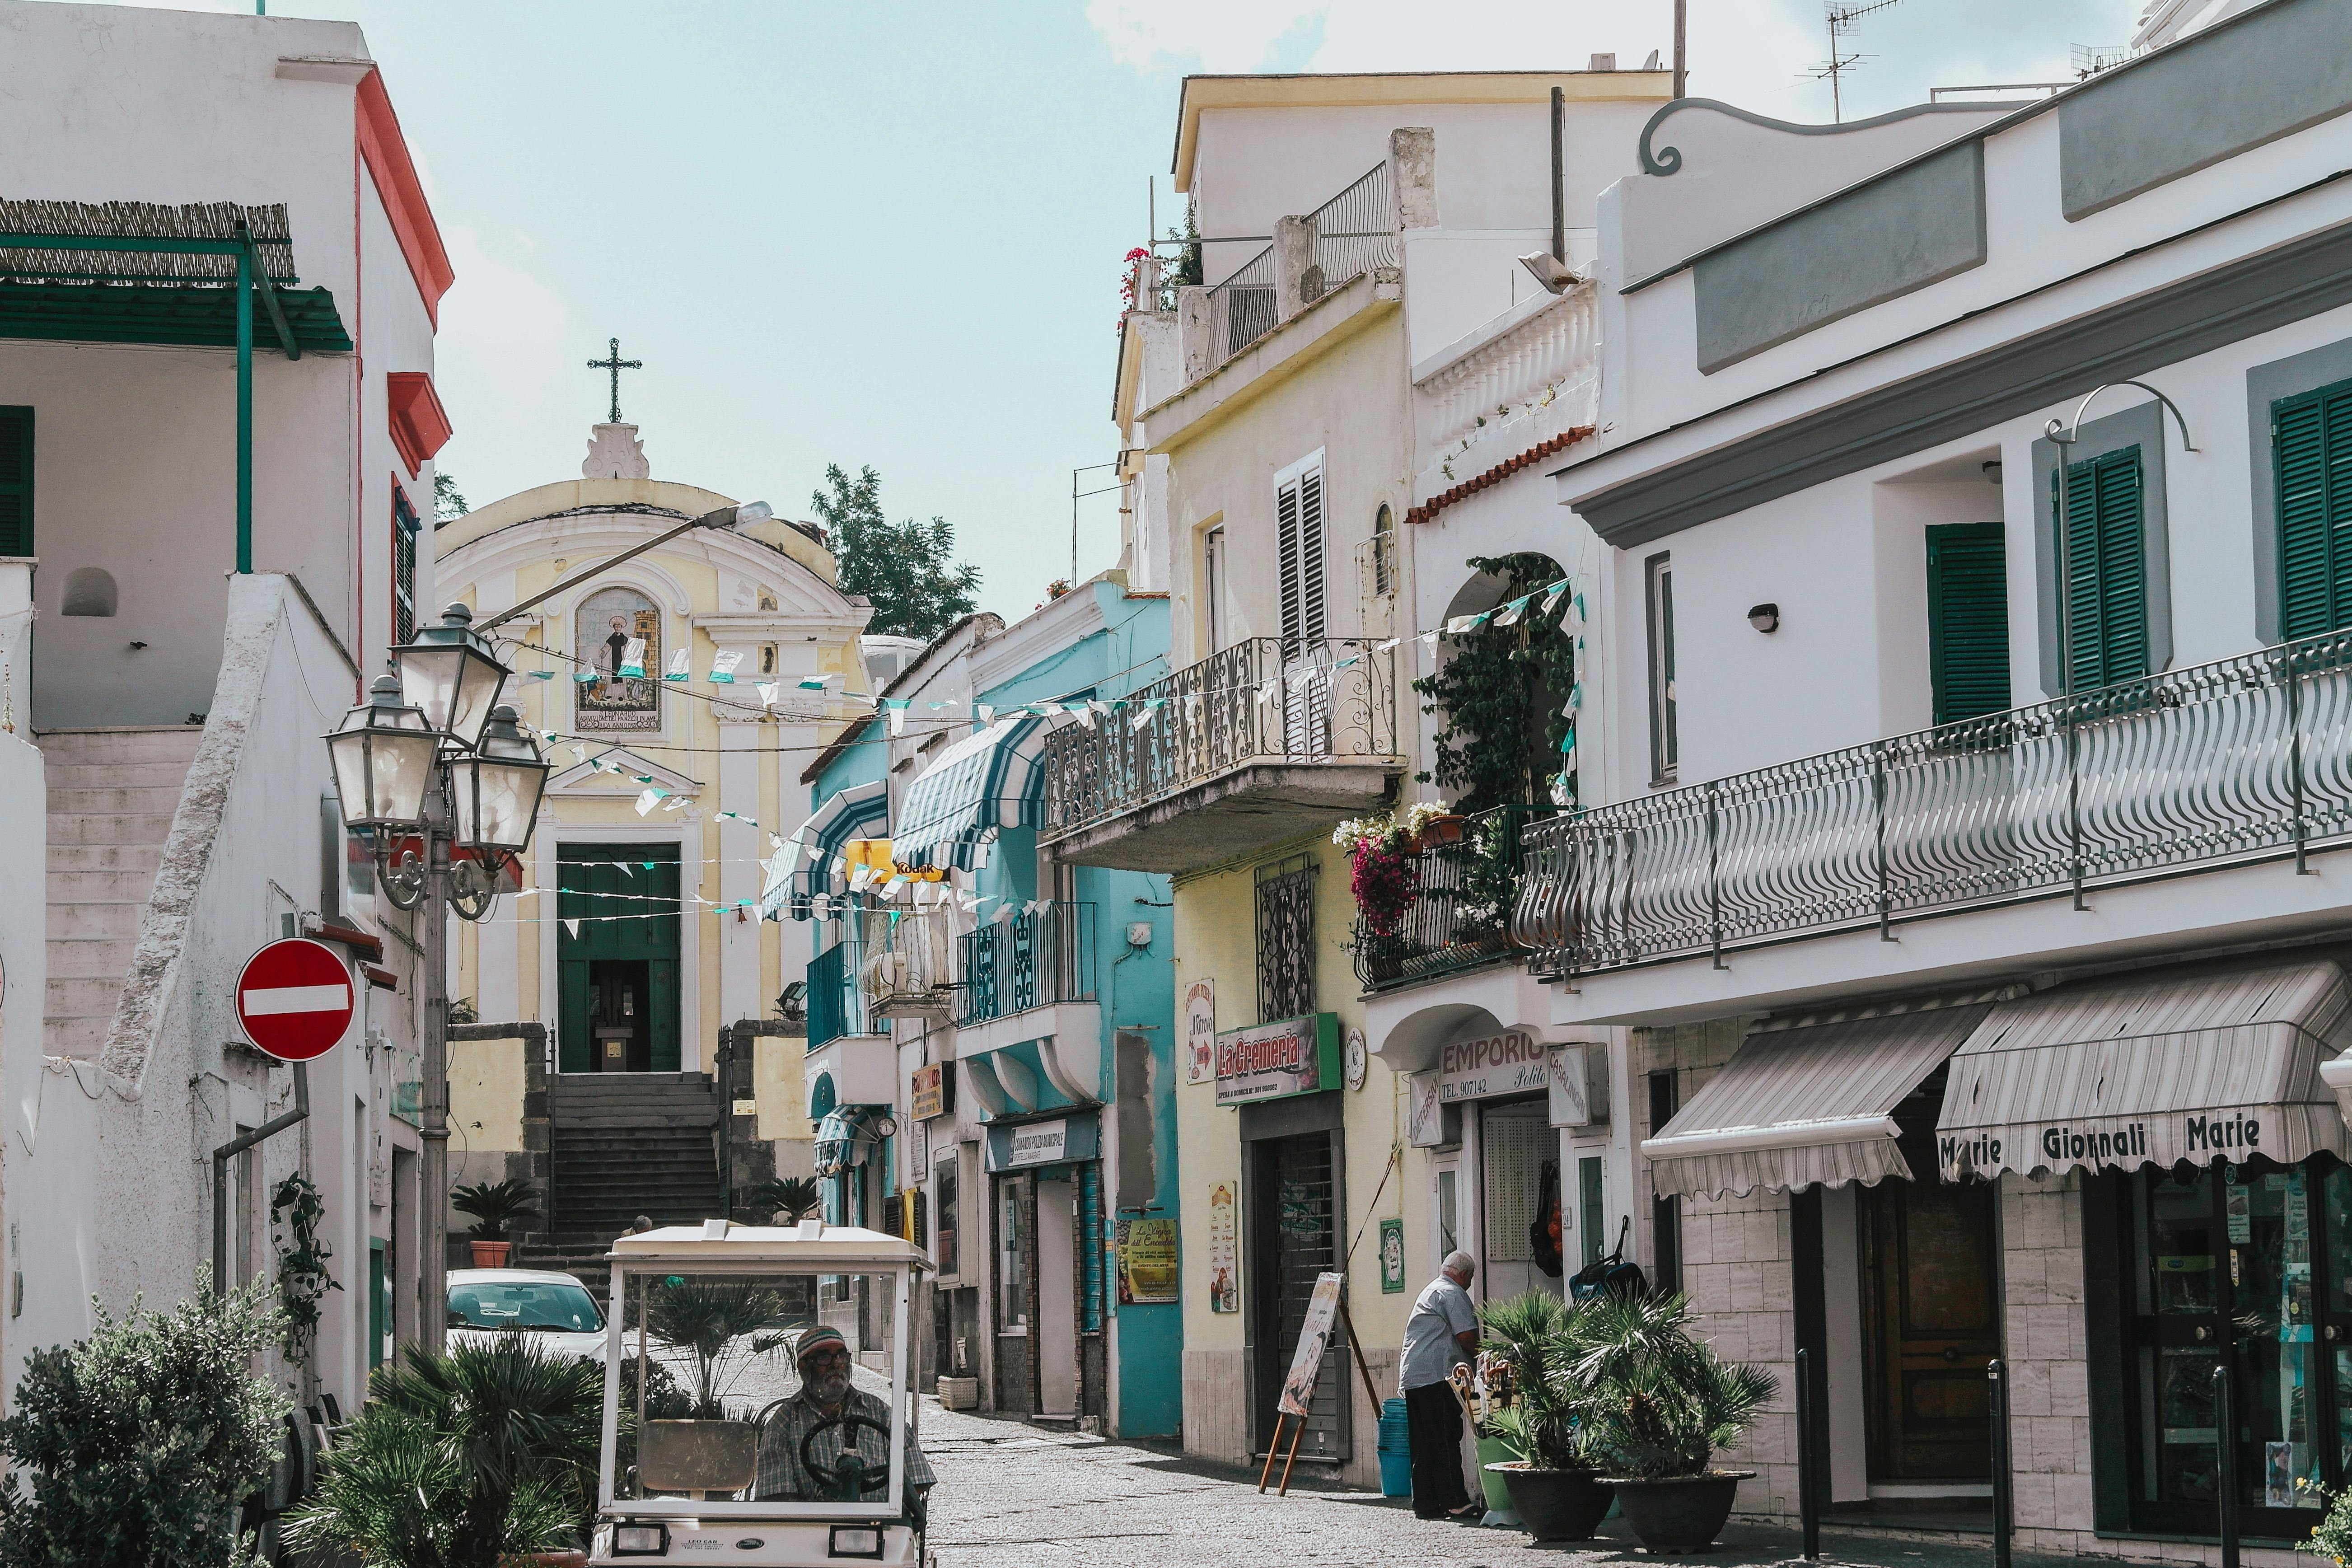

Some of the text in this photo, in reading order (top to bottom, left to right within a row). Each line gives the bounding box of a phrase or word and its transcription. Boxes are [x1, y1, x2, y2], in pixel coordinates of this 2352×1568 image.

[1196, 1015, 1212, 1035] Ritrovo
[1218, 1029, 1299, 1079] La Cremeria
[1442, 1078, 1487, 1098] TEL. 907142
[1514, 1064, 1546, 1088] Polito
[1550, 1052, 1585, 1117] CASALINGHI
[1218, 1091, 1230, 1099] SPESA
[1412, 1075, 1438, 1142] DETERSIVI
[1941, 1112, 2260, 1169] Mrie Giornali Marie
